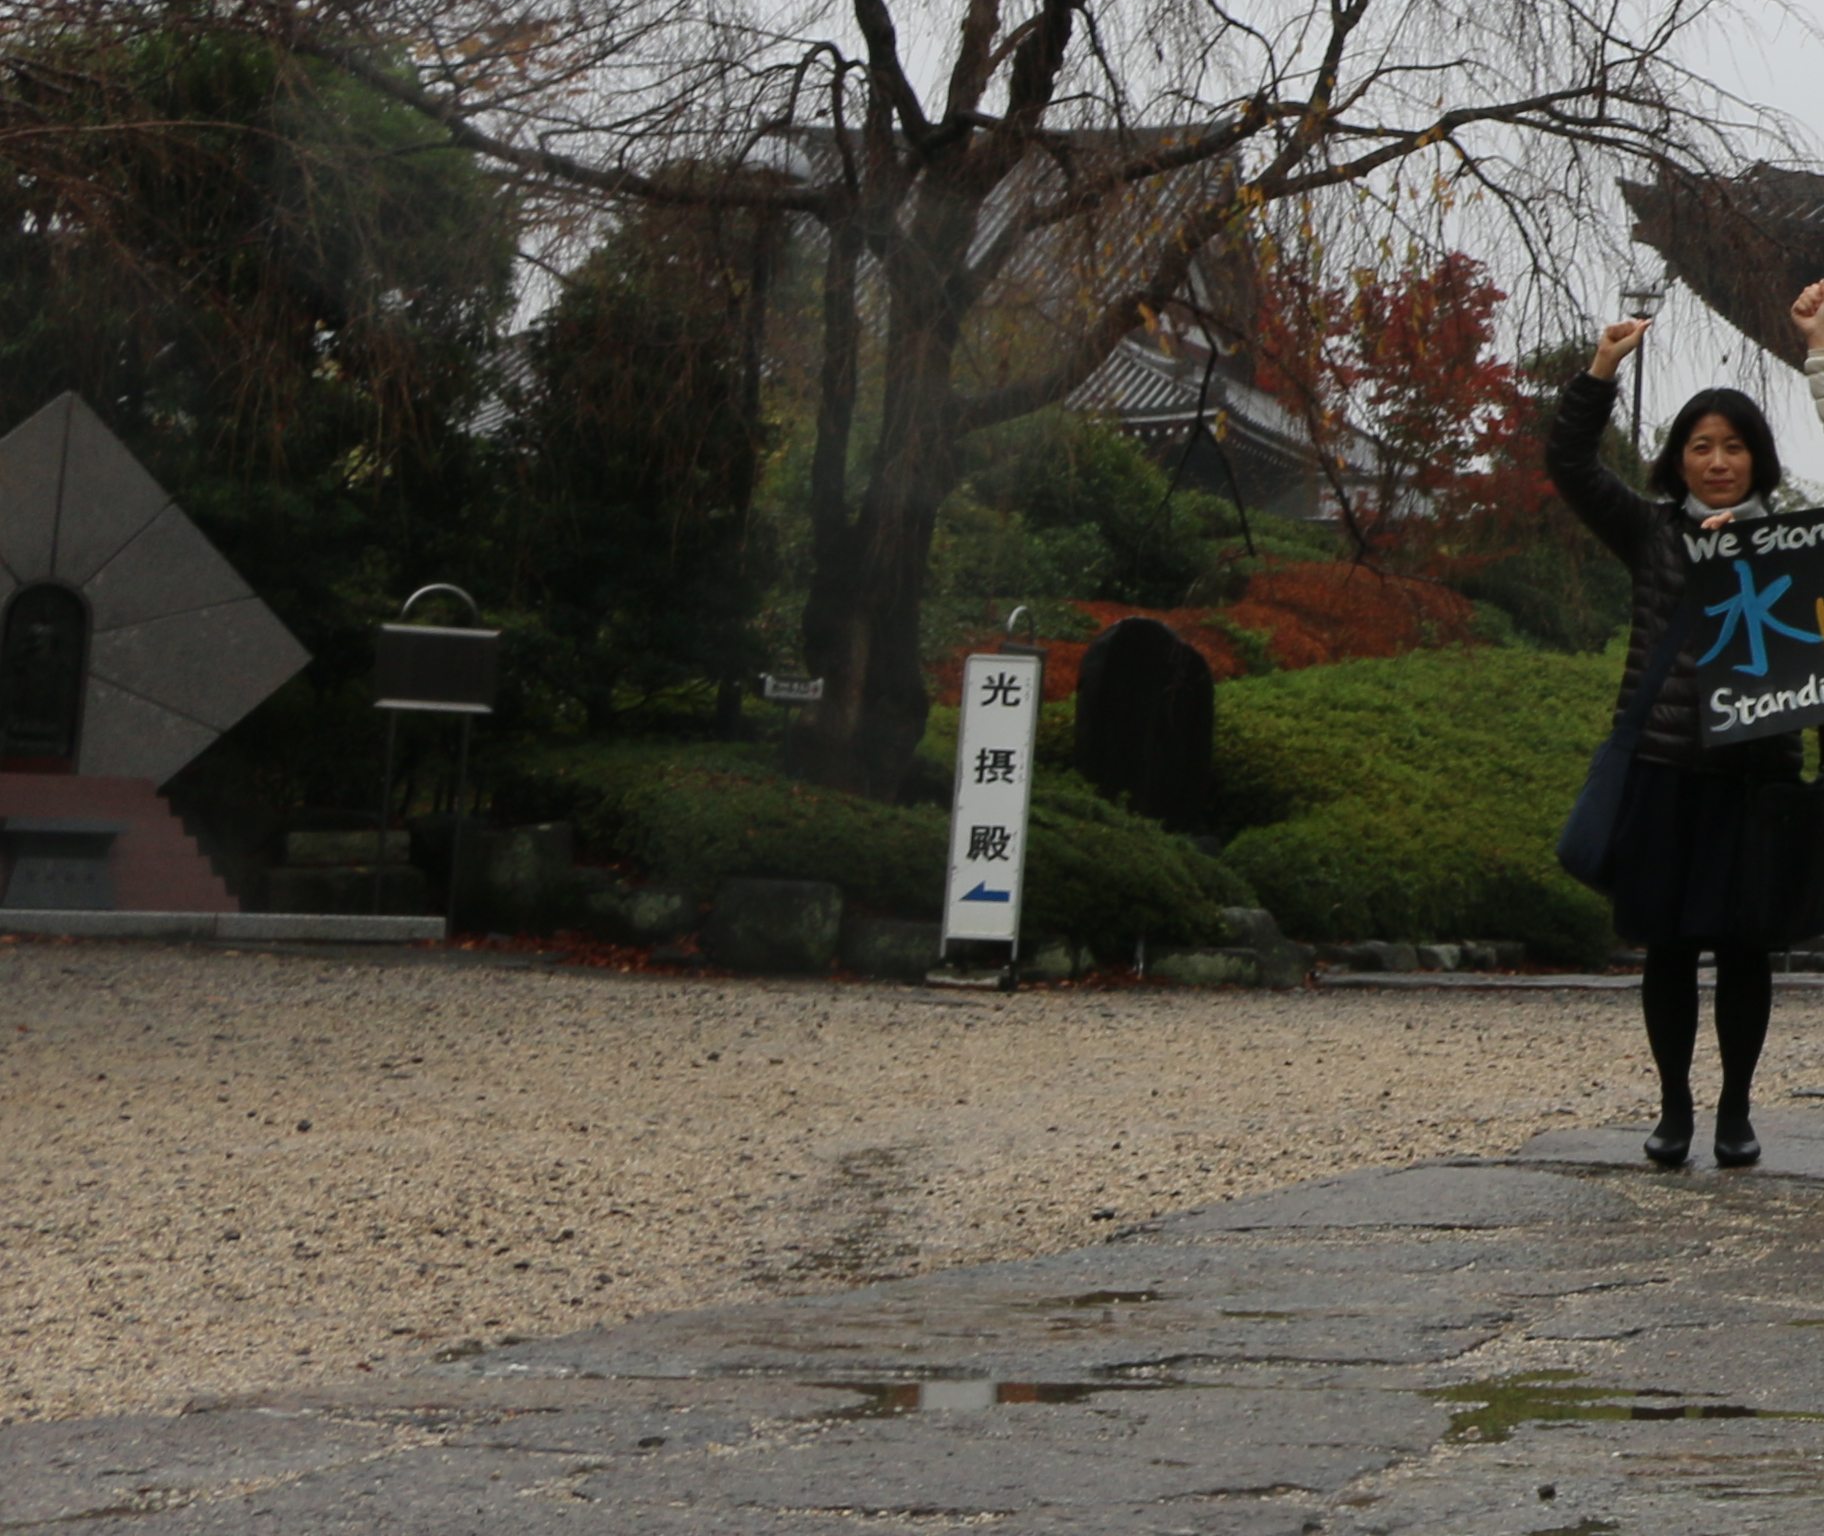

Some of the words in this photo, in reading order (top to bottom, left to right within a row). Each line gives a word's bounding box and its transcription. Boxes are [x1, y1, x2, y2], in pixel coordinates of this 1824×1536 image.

[1682, 531, 1742, 562] We
[966, 672, 1021, 862] 光摂殿
